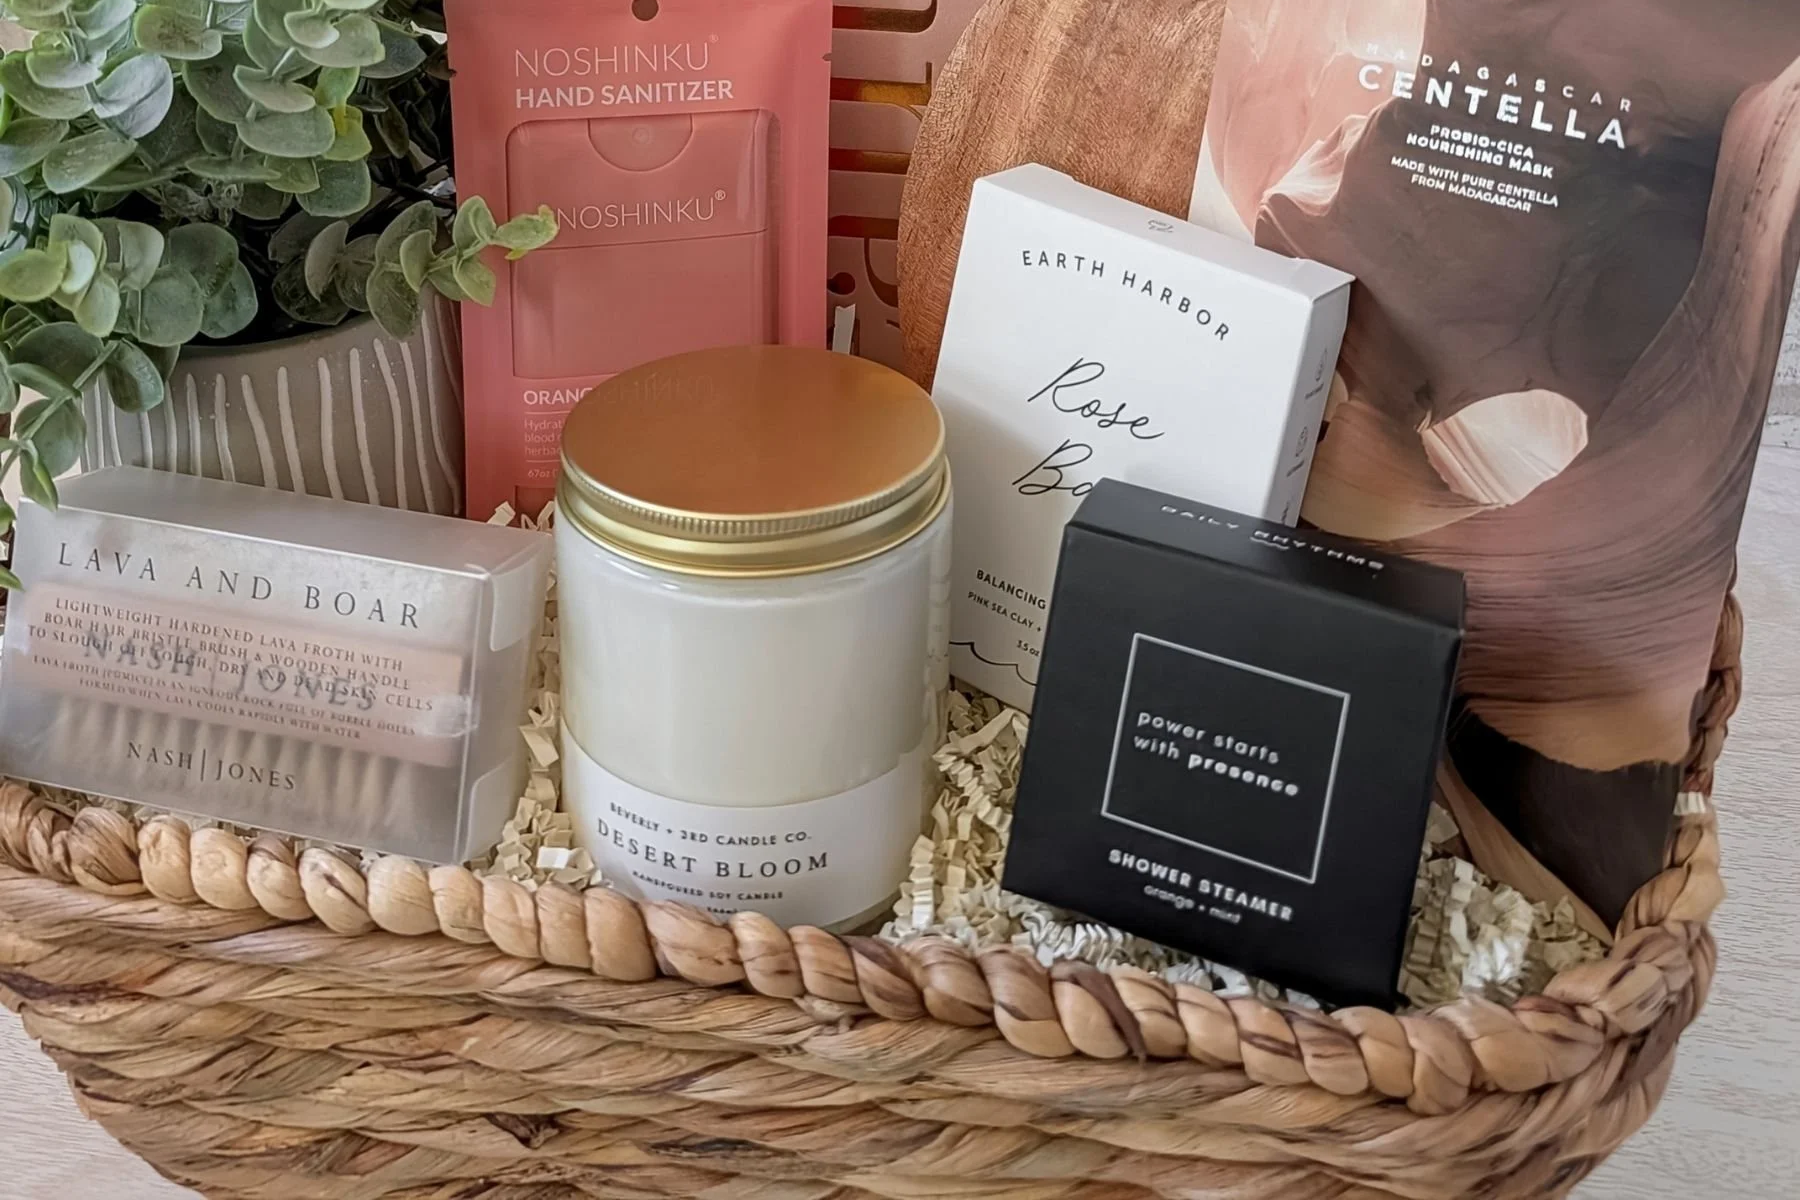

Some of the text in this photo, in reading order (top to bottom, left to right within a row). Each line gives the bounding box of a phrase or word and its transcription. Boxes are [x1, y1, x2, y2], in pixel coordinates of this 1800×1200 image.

[515, 79, 734, 109] HAND SANITIZER
[1366, 42, 1632, 113] MADAGASCAR
[1358, 63, 1626, 150] CENTELLA
[1406, 132, 1554, 179] NOURISHING MASK
[1429, 124, 1534, 160] PROBIO-CICA
[1390, 156, 1559, 208] MADE WITH PURE CENTELLA
[1411, 173, 1532, 213] FROM MADAGASCAR
[1022, 249, 1230, 341] EARTH HARBOR
[1027, 357, 1165, 440] Rose
[524, 419, 564, 431] Hydrat
[1161, 505, 1240, 529] DAILY
[59, 542, 418, 629] LAVA AND BOAR
[967, 591, 989, 608] PINK
[991, 603, 1008, 617] SEA
[1010, 612, 1034, 628] CLAY
[976, 569, 1047, 610] BALANCING
[44, 612, 83, 629] BOAR
[90, 619, 125, 637] HAIR
[132, 626, 191, 649] BRISTLE
[199, 639, 248, 660] BRUSH
[269, 652, 340, 677] WOODEN
[347, 668, 411, 691] HANDLE
[56, 597, 403, 672] LIGHTWEIGHT HARDENED LAVA FROTH WITH
[28, 624, 46, 639] TO
[385, 693, 434, 711] CELLS
[1136, 712, 1280, 764] power starts
[127, 741, 296, 790] NASH JONES
[1133, 735, 1299, 797] with presence
[597, 817, 828, 879] DESERT BLOOM
[610, 801, 660, 832] BEVERLY
[715, 834, 777, 846] CANDLE
[1108, 848, 1293, 921] SHOWER STEAMER
